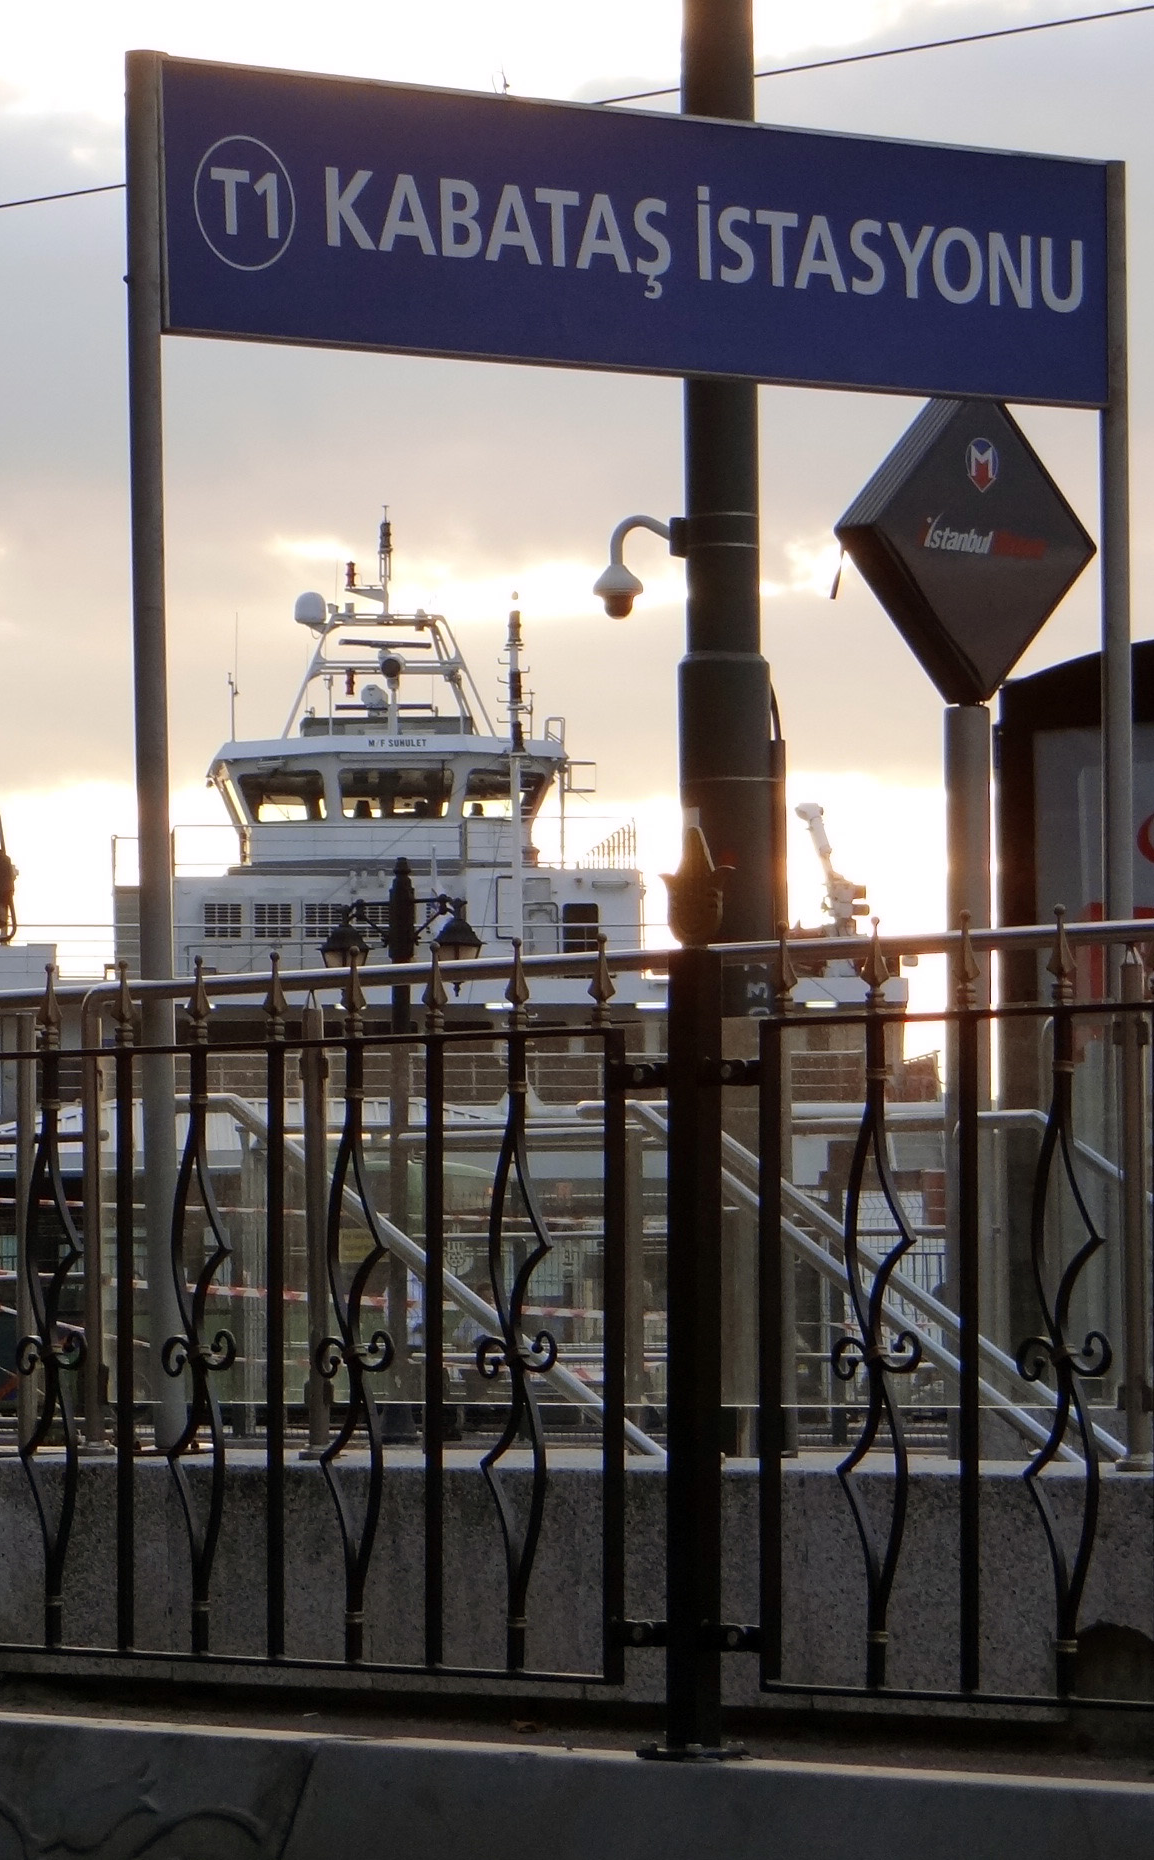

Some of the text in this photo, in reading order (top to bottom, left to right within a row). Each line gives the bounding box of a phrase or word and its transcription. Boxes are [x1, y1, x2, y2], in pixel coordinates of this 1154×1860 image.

[210, 166, 1084, 314] T1 KABATAŞ İSTASYONU
